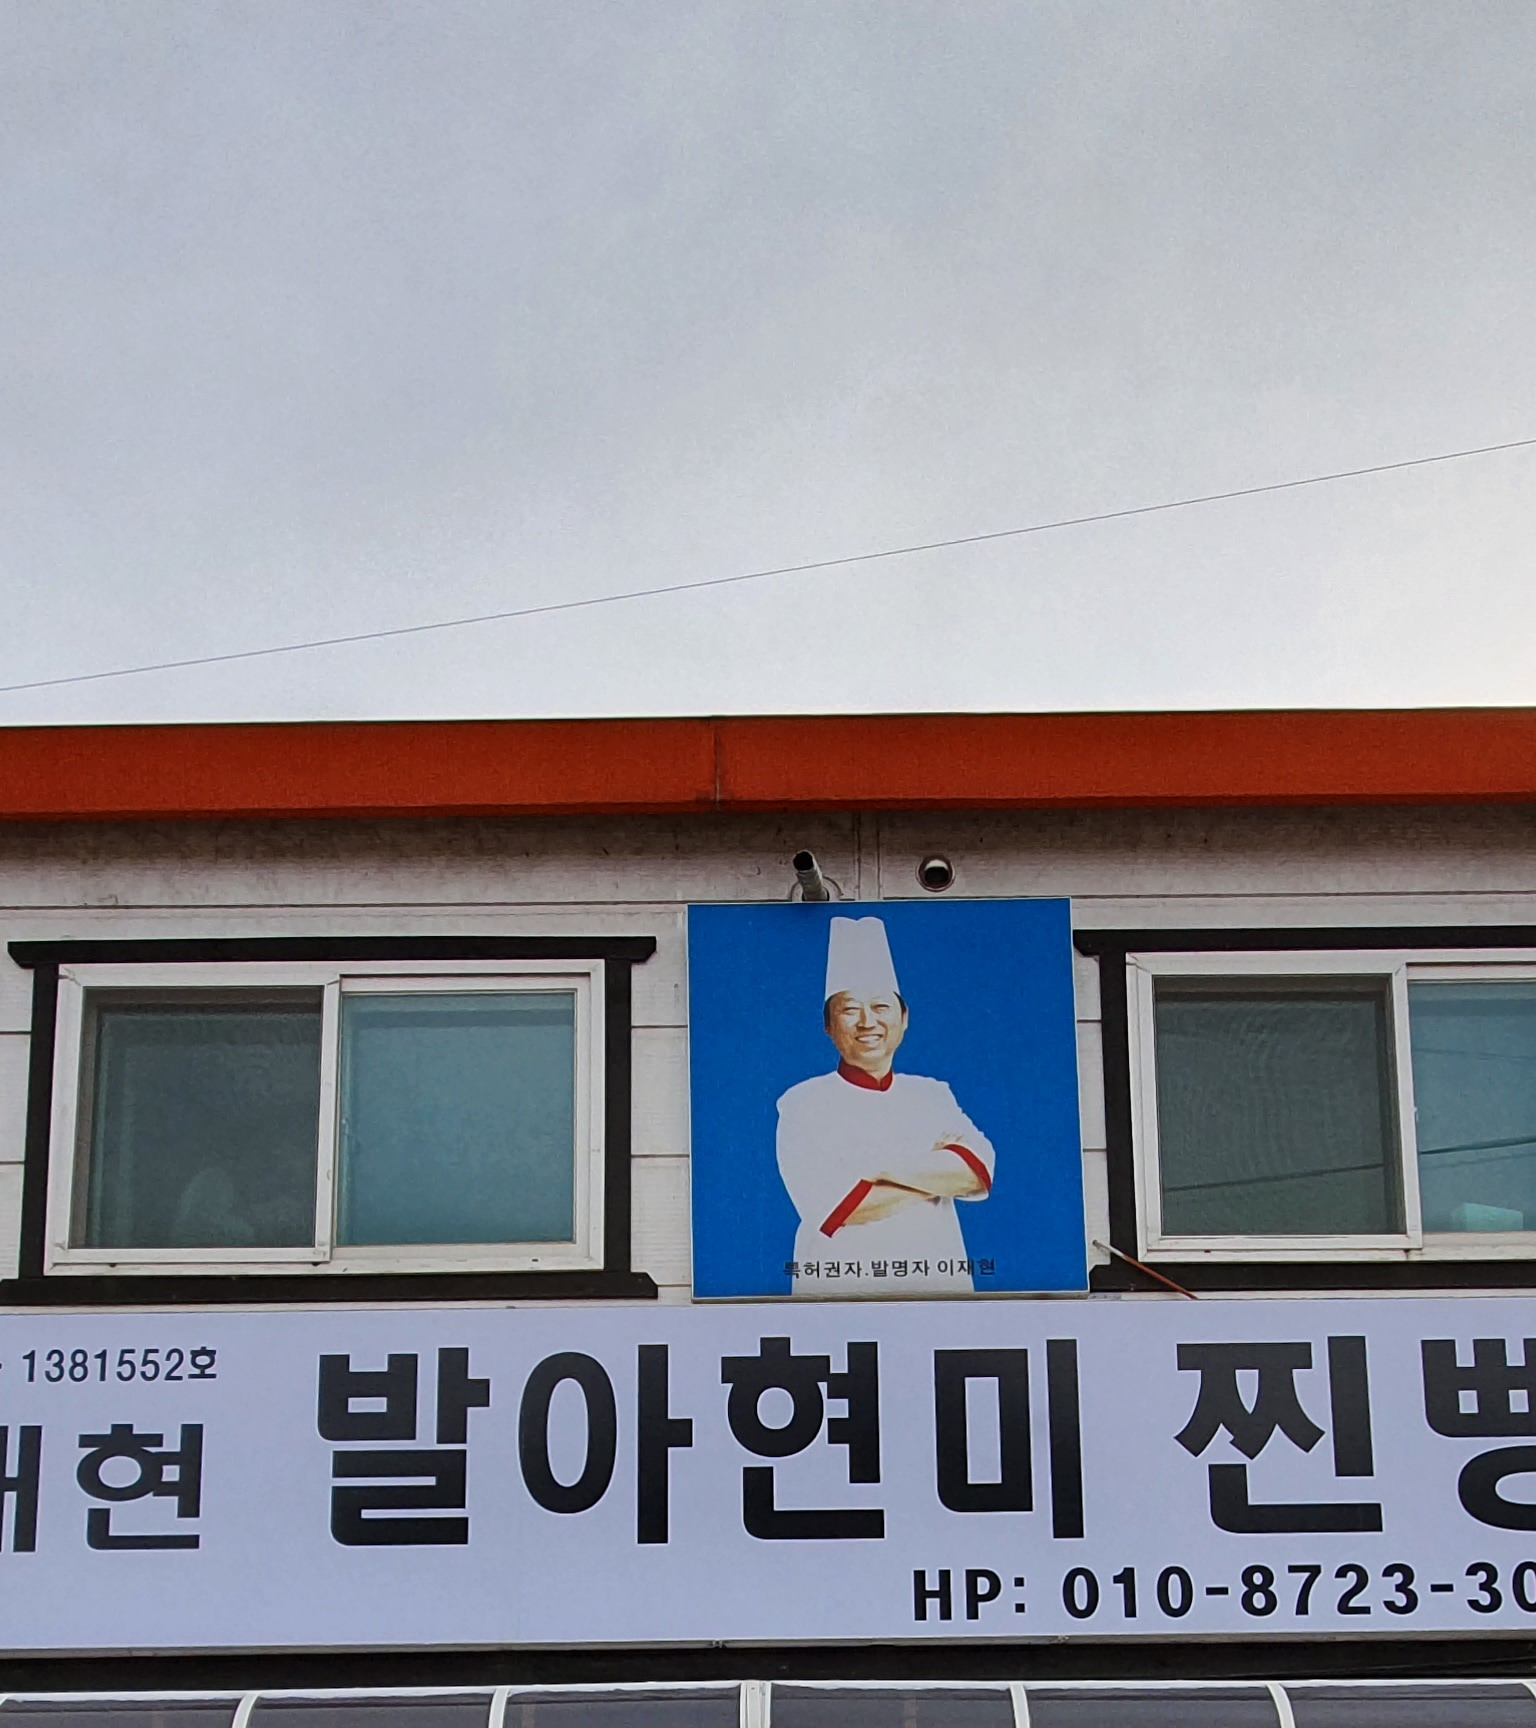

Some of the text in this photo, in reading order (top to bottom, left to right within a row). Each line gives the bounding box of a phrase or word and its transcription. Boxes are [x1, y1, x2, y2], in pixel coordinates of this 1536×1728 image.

[937, 1257, 997, 1277] 이재현
[22, 1346, 218, 1383] 1381552호
[316, 1335, 1086, 1547] 발아현미
[912, 1568, 1027, 1622] HP:
